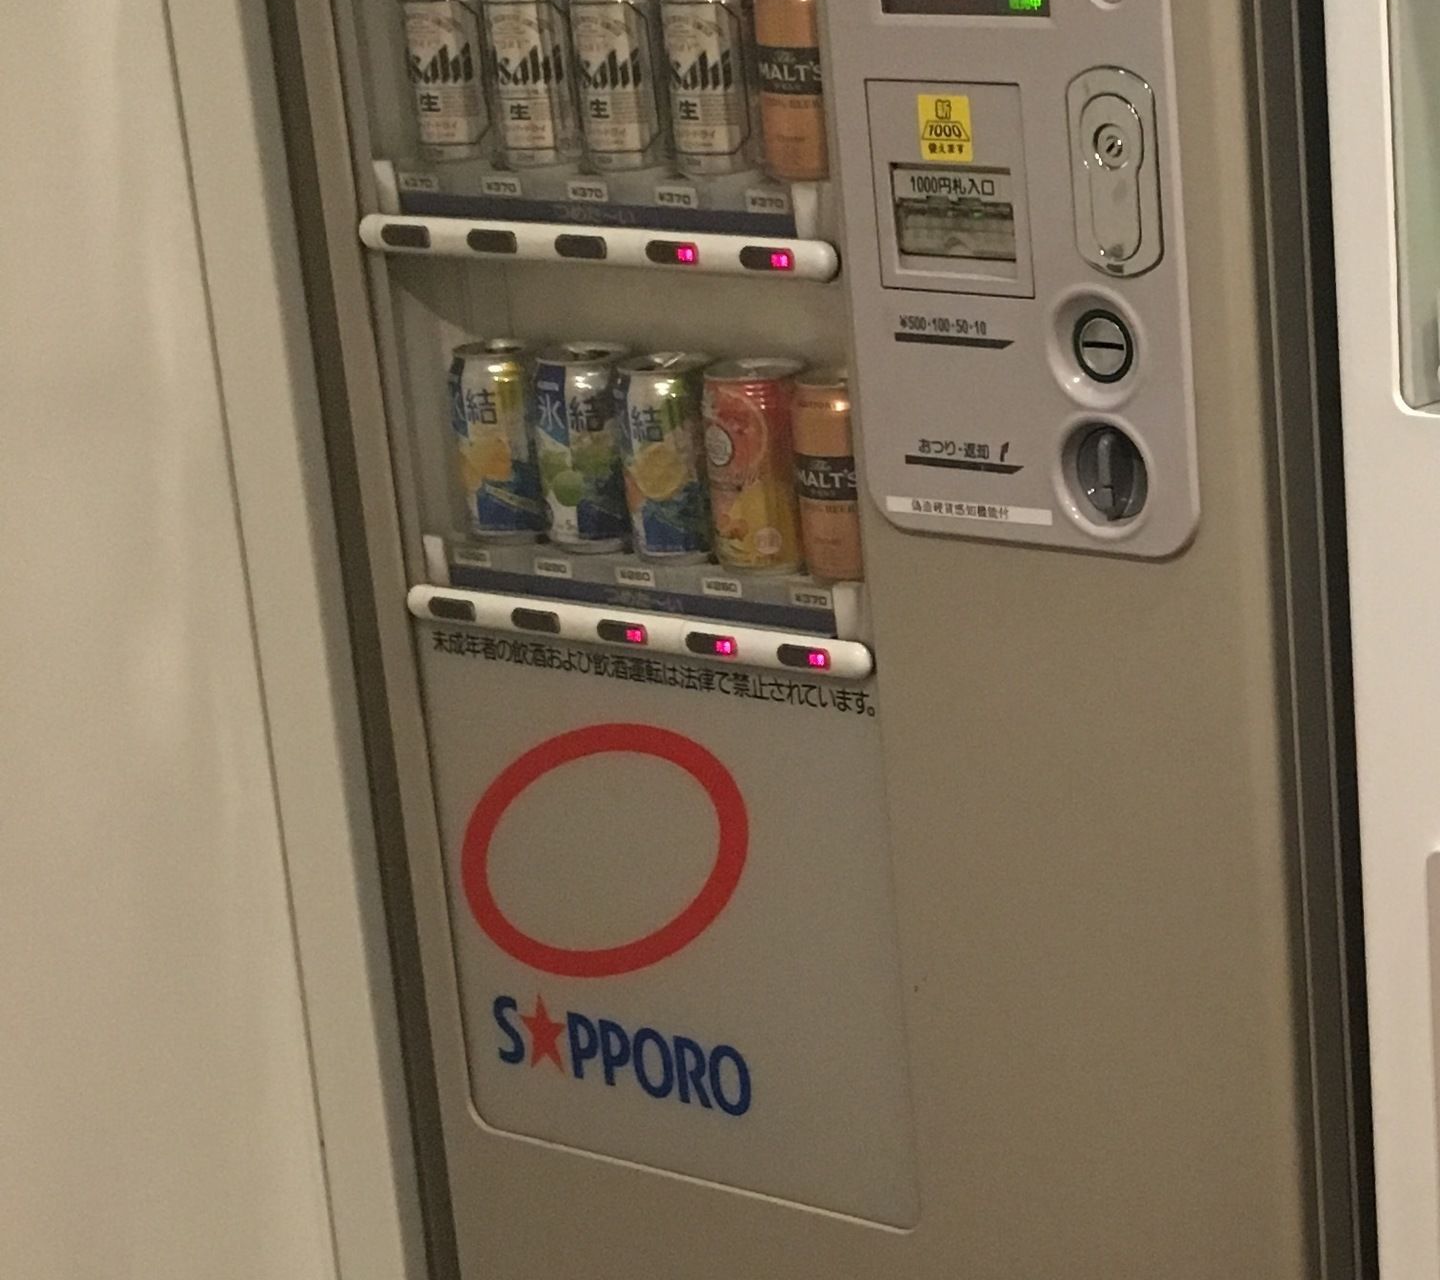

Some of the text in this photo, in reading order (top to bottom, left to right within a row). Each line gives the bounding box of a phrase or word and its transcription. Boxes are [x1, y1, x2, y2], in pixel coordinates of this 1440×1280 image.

[419, 92, 442, 113] 生
[509, 102, 532, 121] 生
[588, 98, 610, 119] 生
[679, 99, 700, 121] 生
[935, 98, 953, 121] 新
[926, 123, 963, 140] 1000
[909, 175, 996, 197] 1000円札入口
[917, 438, 990, 460] おつり・返却
[432, 630, 876, 717] 未成年者の飲酒および飲酒運転は法律で禁止されています。
